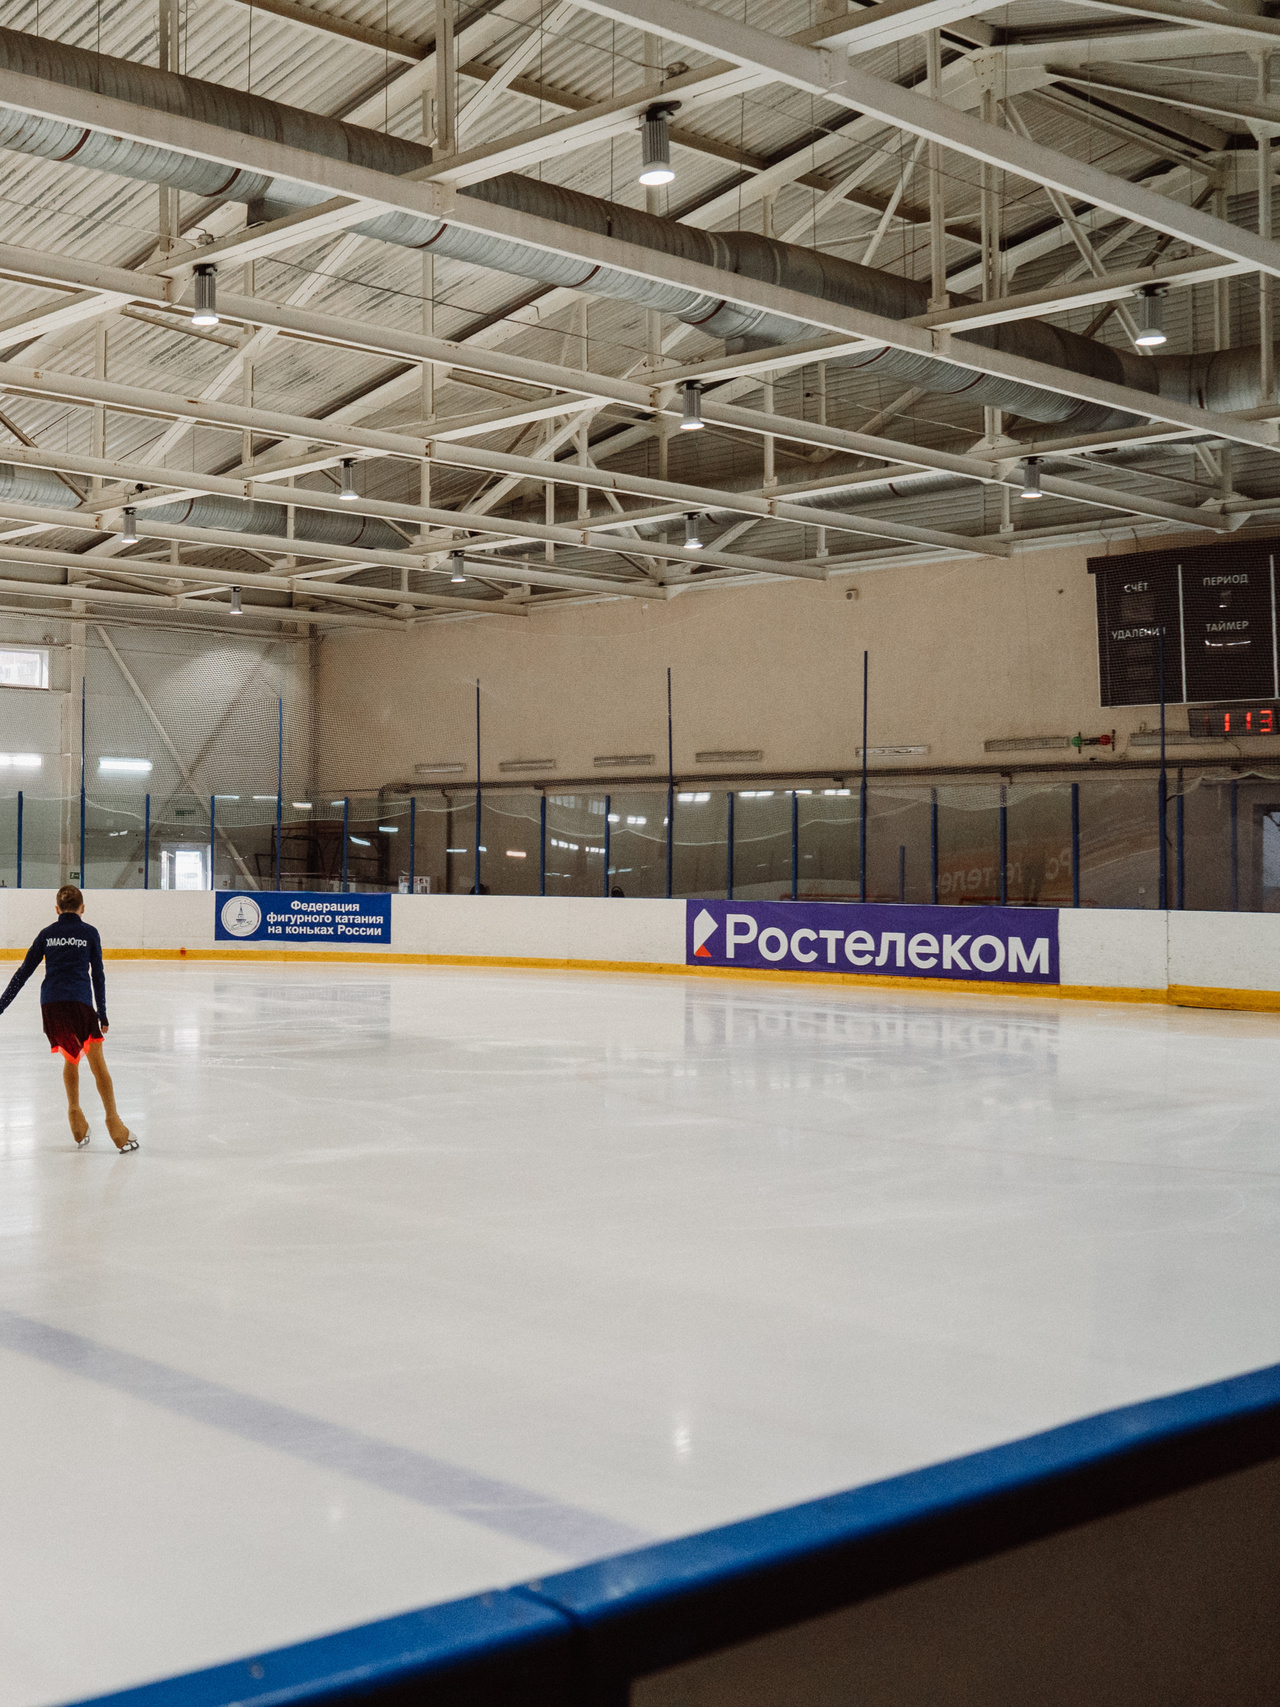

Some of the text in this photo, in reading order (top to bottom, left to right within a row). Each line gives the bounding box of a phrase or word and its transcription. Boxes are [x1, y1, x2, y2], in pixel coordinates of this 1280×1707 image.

[1203, 573, 1249, 587] ПЕРИОД
[1123, 581, 1149, 593] СЧЁТ
[1205, 620, 1249, 633] ТАЙМЕР
[290, 900, 360, 913] Федерация
[266, 912, 384, 925] фигурного катания
[268, 925, 382, 936] на коньках России
[726, 913, 1050, 975] Ростелеком
